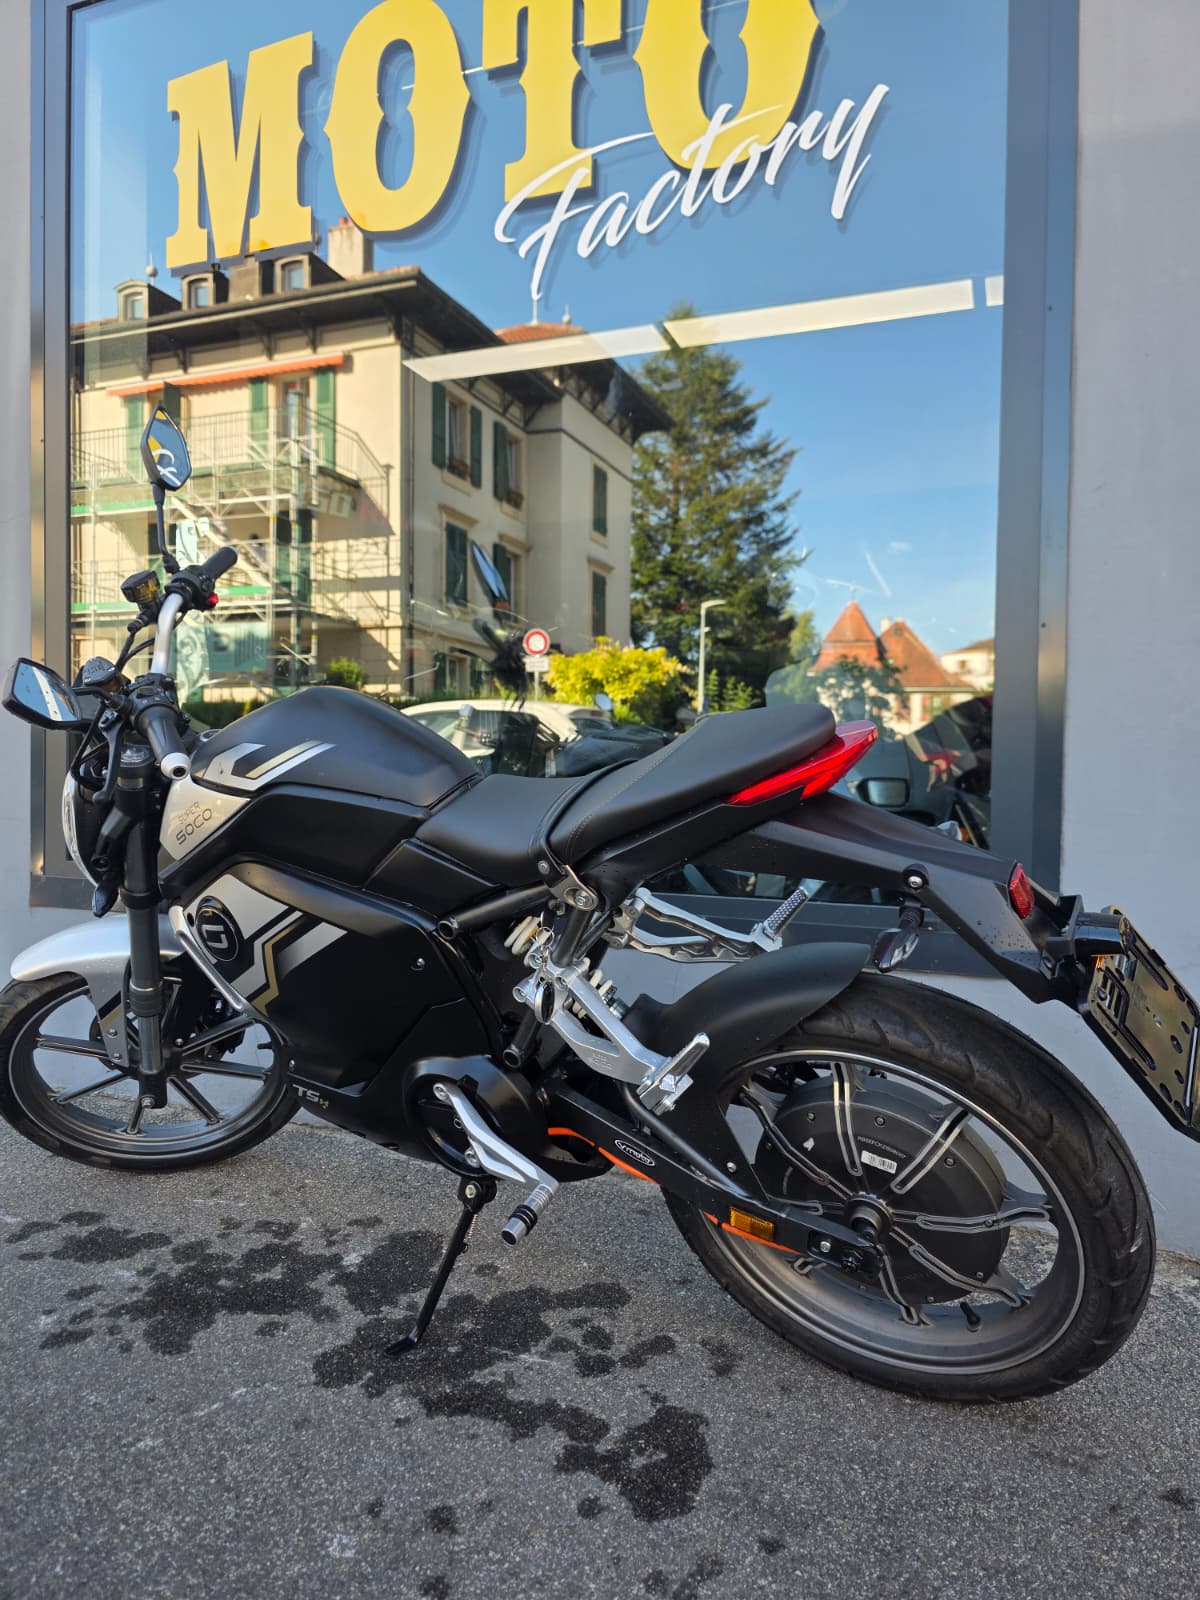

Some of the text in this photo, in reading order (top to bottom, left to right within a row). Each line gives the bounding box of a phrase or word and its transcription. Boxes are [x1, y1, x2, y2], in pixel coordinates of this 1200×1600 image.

[165, 0, 823, 269] MOTO
[494, 83, 890, 301] Factory
[176, 808, 212, 845] SOCO
